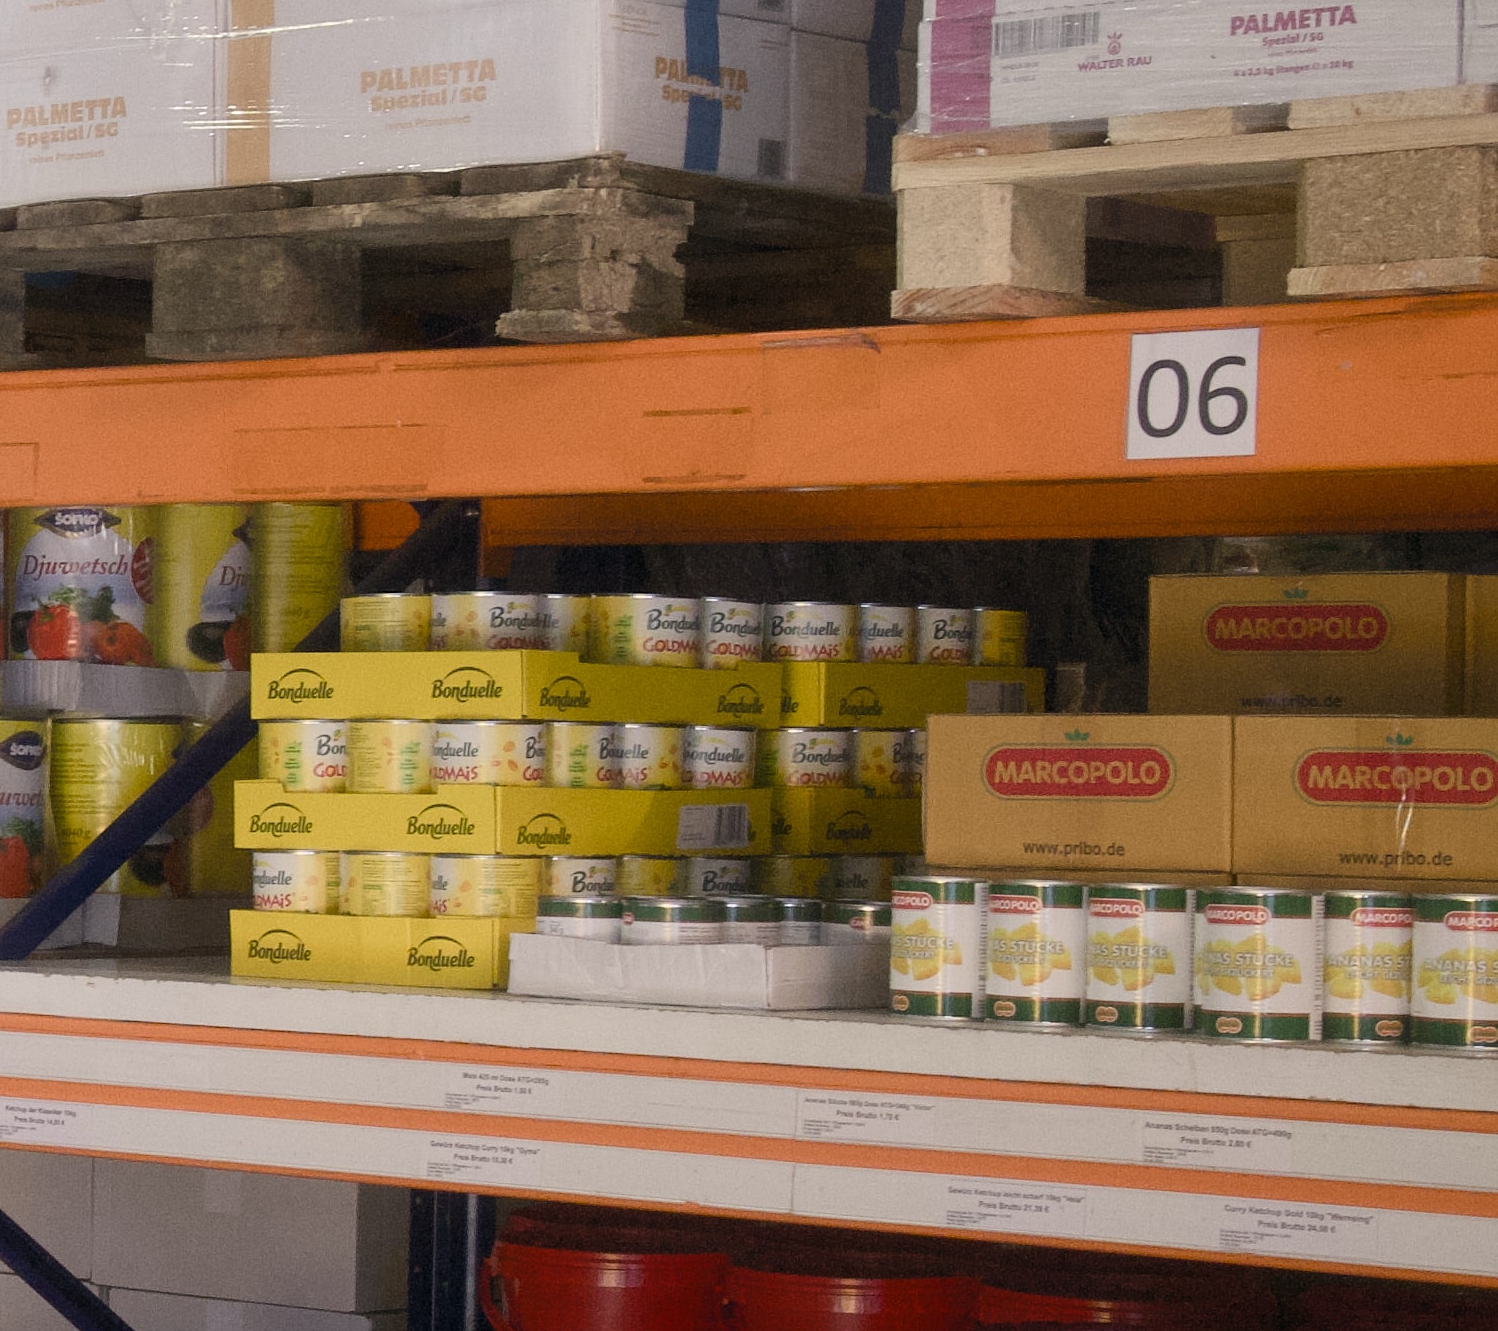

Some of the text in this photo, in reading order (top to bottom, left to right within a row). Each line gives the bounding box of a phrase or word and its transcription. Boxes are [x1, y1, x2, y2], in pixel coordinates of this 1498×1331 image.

[1230, 4, 1357, 35] PALMETTA
[360, 59, 497, 92] PALMETTA
[1078, 55, 1153, 72] WALTER RAU
[5, 96, 127, 130] PALMETTA
[1136, 355, 1249, 439] 06
[23, 553, 129, 580] Djuwetsch
[770, 615, 841, 638] Bonduelle
[1214, 614, 1379, 641] MARCOPOLO
[268, 678, 334, 703] Bonduelle
[431, 678, 503, 701] Bonduelle
[539, 686, 591, 711] Bonduelle
[993, 759, 1162, 786] MARCOPOLO
[1307, 763, 1495, 791] MARCOPOLO
[249, 814, 313, 837] Bonduelle
[407, 815, 475, 838] Bonduelle
[517, 824, 571, 847] Bonduelle
[1023, 840, 1126, 858] www.pribo.de
[1339, 850, 1453, 869] www.pribo.de
[248, 938, 312, 963] Bonduelle
[407, 947, 475, 970] Bonduelle
[1235, 952, 1293, 968] STÜCKE
